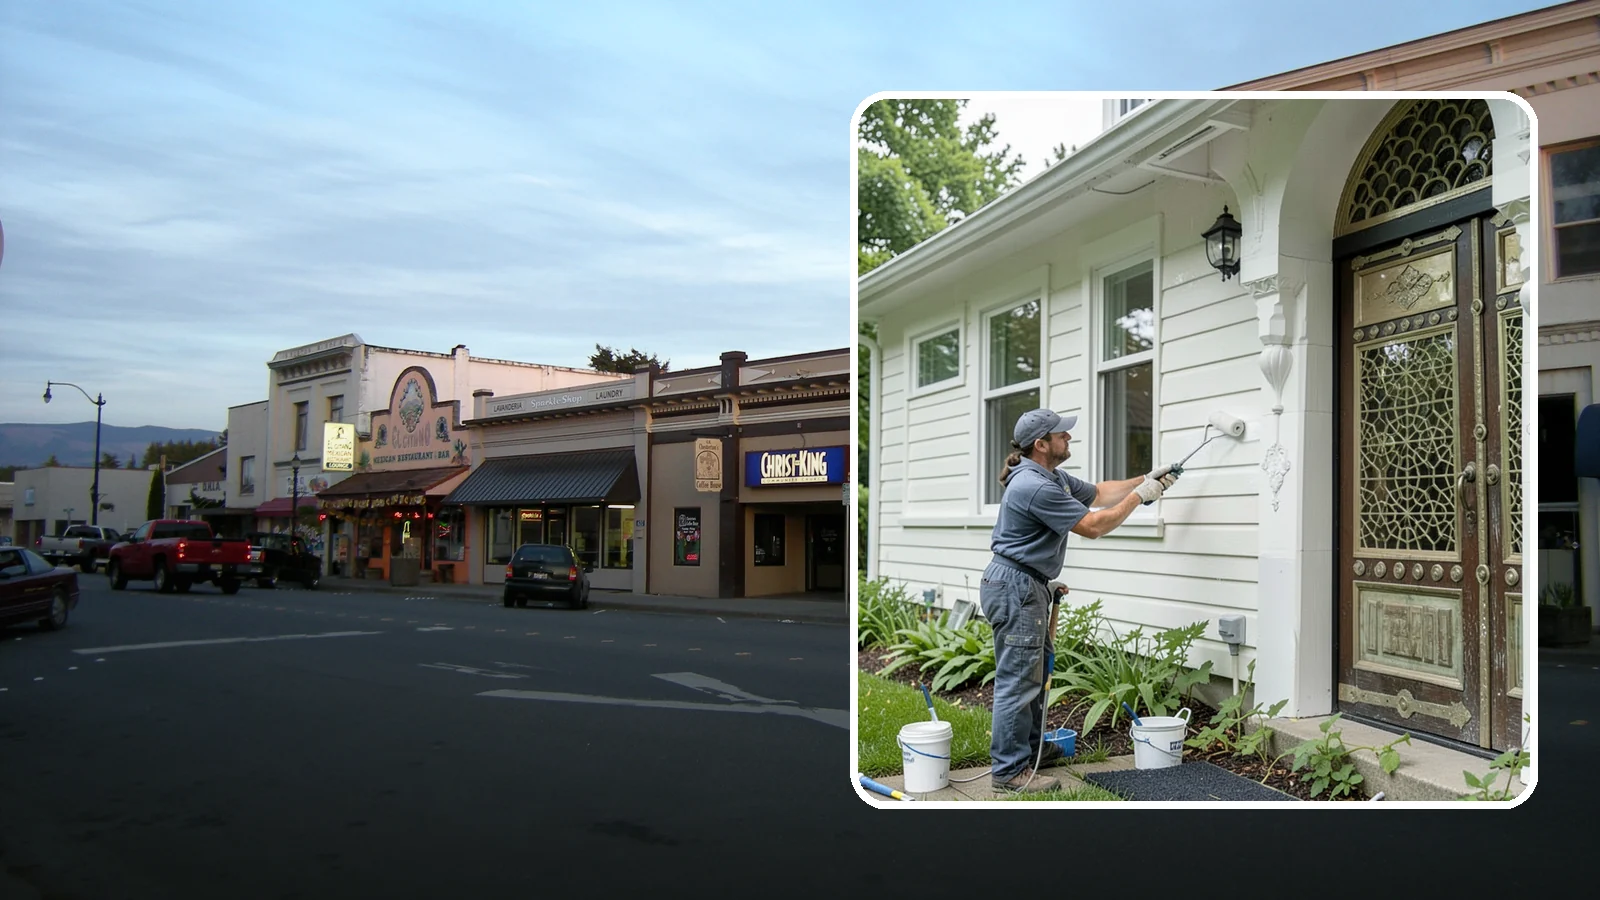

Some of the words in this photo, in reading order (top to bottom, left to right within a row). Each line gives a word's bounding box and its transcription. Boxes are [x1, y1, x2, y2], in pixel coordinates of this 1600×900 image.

[561, 394, 583, 405] Shop
[595, 389, 623, 400] LAUNDRY
[493, 402, 522, 413] LAVANDERIA
[373, 455, 396, 464] MEXICAN
[397, 451, 433, 463] RESTAURANT
[438, 450, 450, 459] BAR
[761, 452, 797, 478] CHRIST
[799, 449, 827, 476] KING
[696, 481, 709, 489] Coffee
